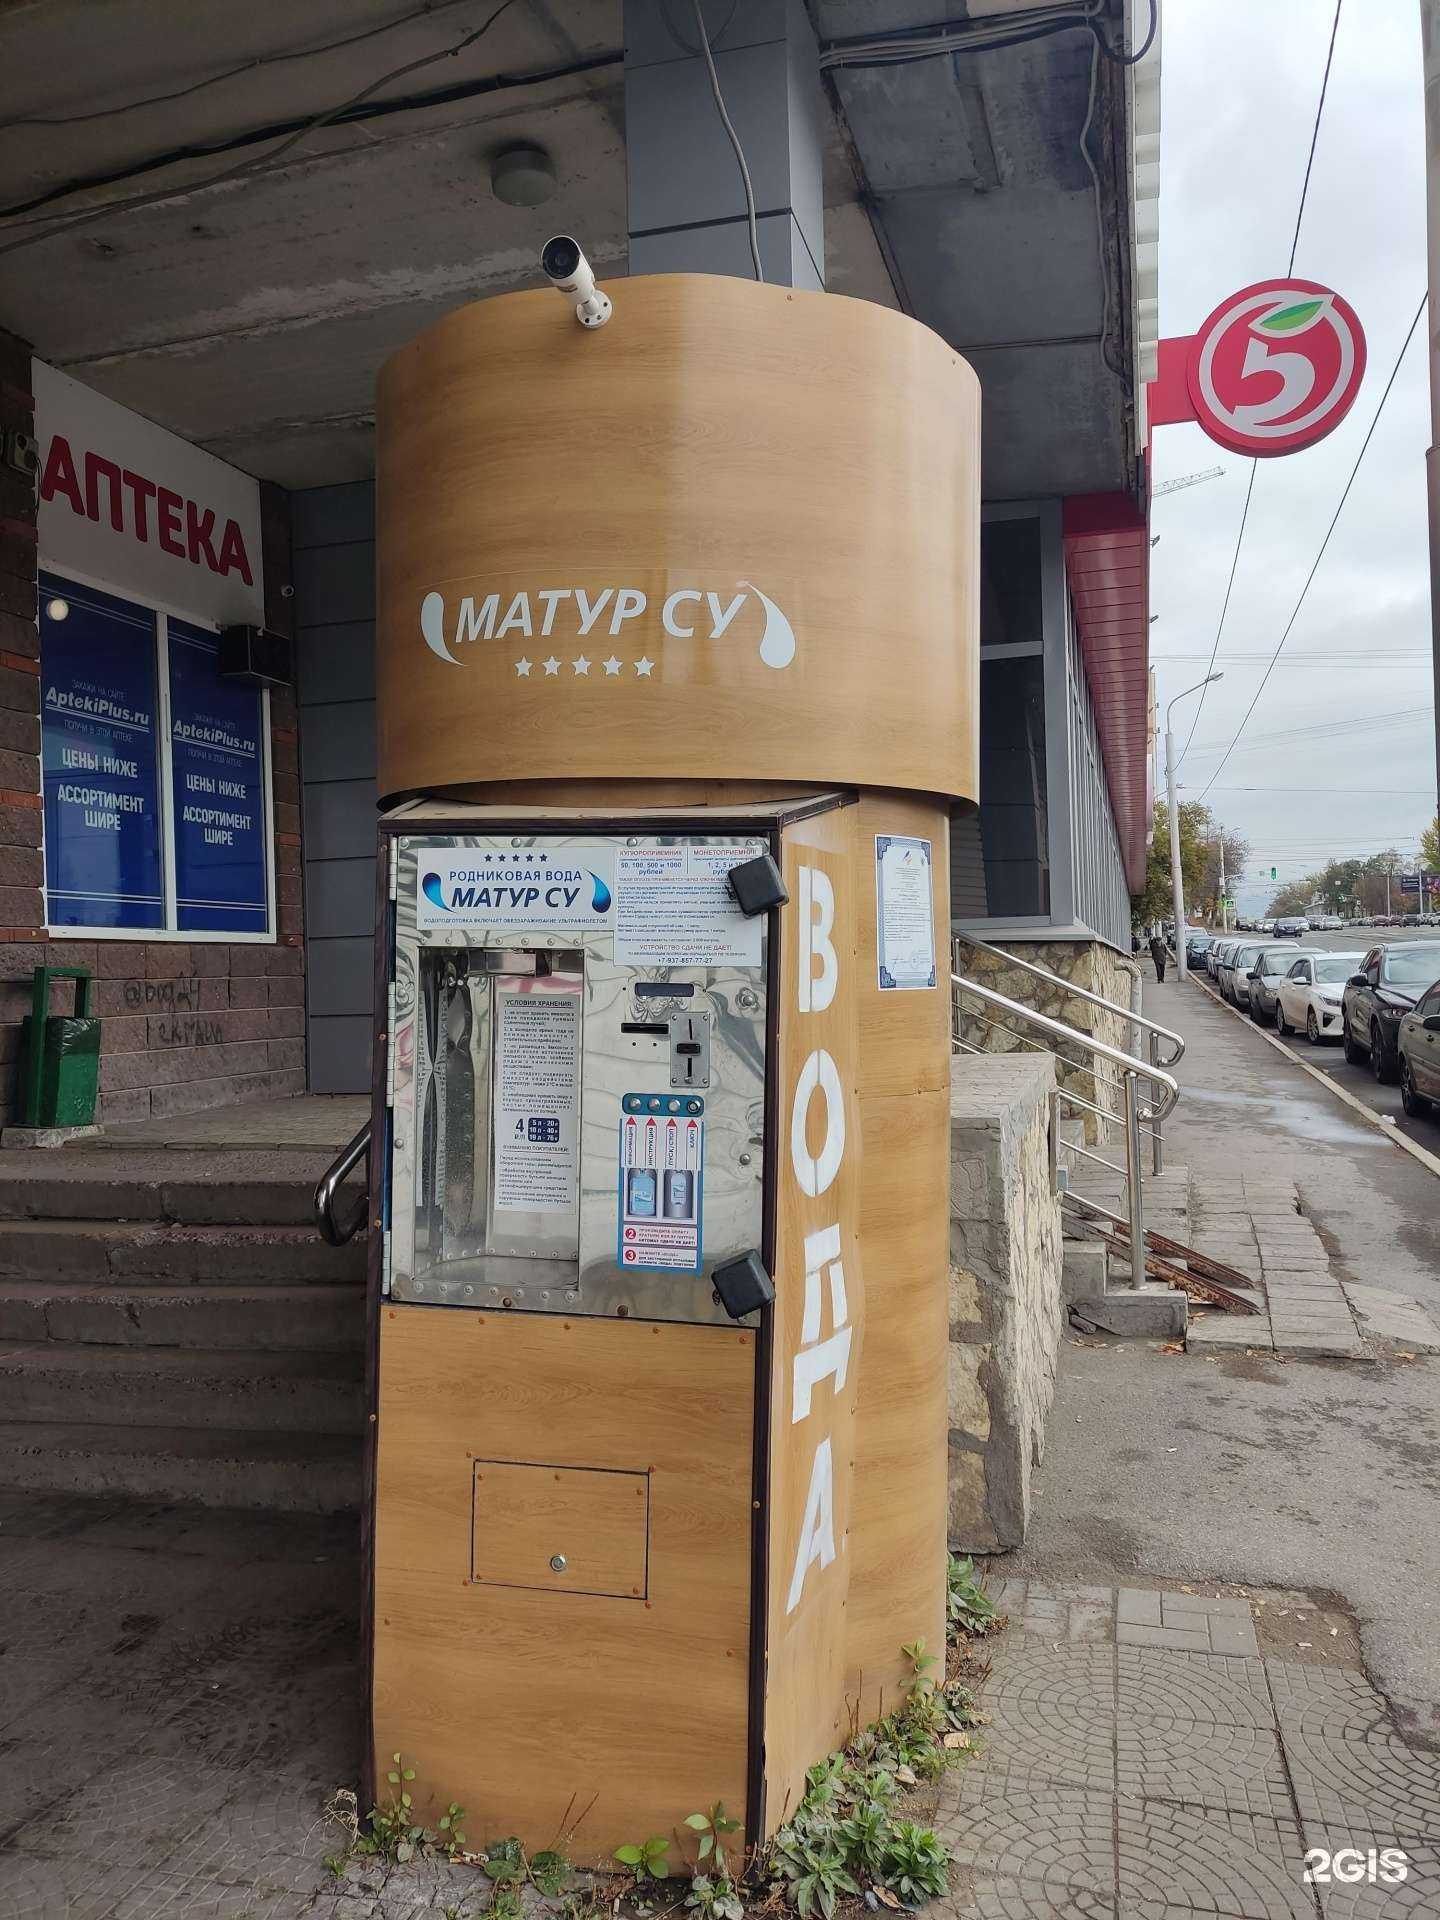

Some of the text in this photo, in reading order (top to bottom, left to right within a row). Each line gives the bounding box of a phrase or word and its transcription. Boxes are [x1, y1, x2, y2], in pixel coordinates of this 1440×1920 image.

[41, 435, 253, 586] АПТЕКА
[455, 588, 748, 643] МАТУР СУ
[46, 687, 149, 726] AptekiPlus.ru
[173, 719, 255, 752] AptekiPlus.ru
[62, 748, 138, 779] ЦЕНЫ НИЖЕ
[57, 784, 144, 814] АССОРТИМЕНТ
[186, 774, 246, 800] ЦЕНЫ НИЖЕ
[85, 809, 121, 831] ШИРЕ
[183, 806, 251, 830] АССОРТИМЕНТ
[204, 828, 234, 846] ШИРЕ
[449, 870, 582, 882] РОДНИКОВАЯ ВОДА
[451, 887, 581, 908] МАТУР СУ
[515, 1118, 525, 1133] 4
[628, 1230, 634, 1238] 2
[786, 864, 853, 1615] ВОДА
[628, 1252, 634, 1260] 3
